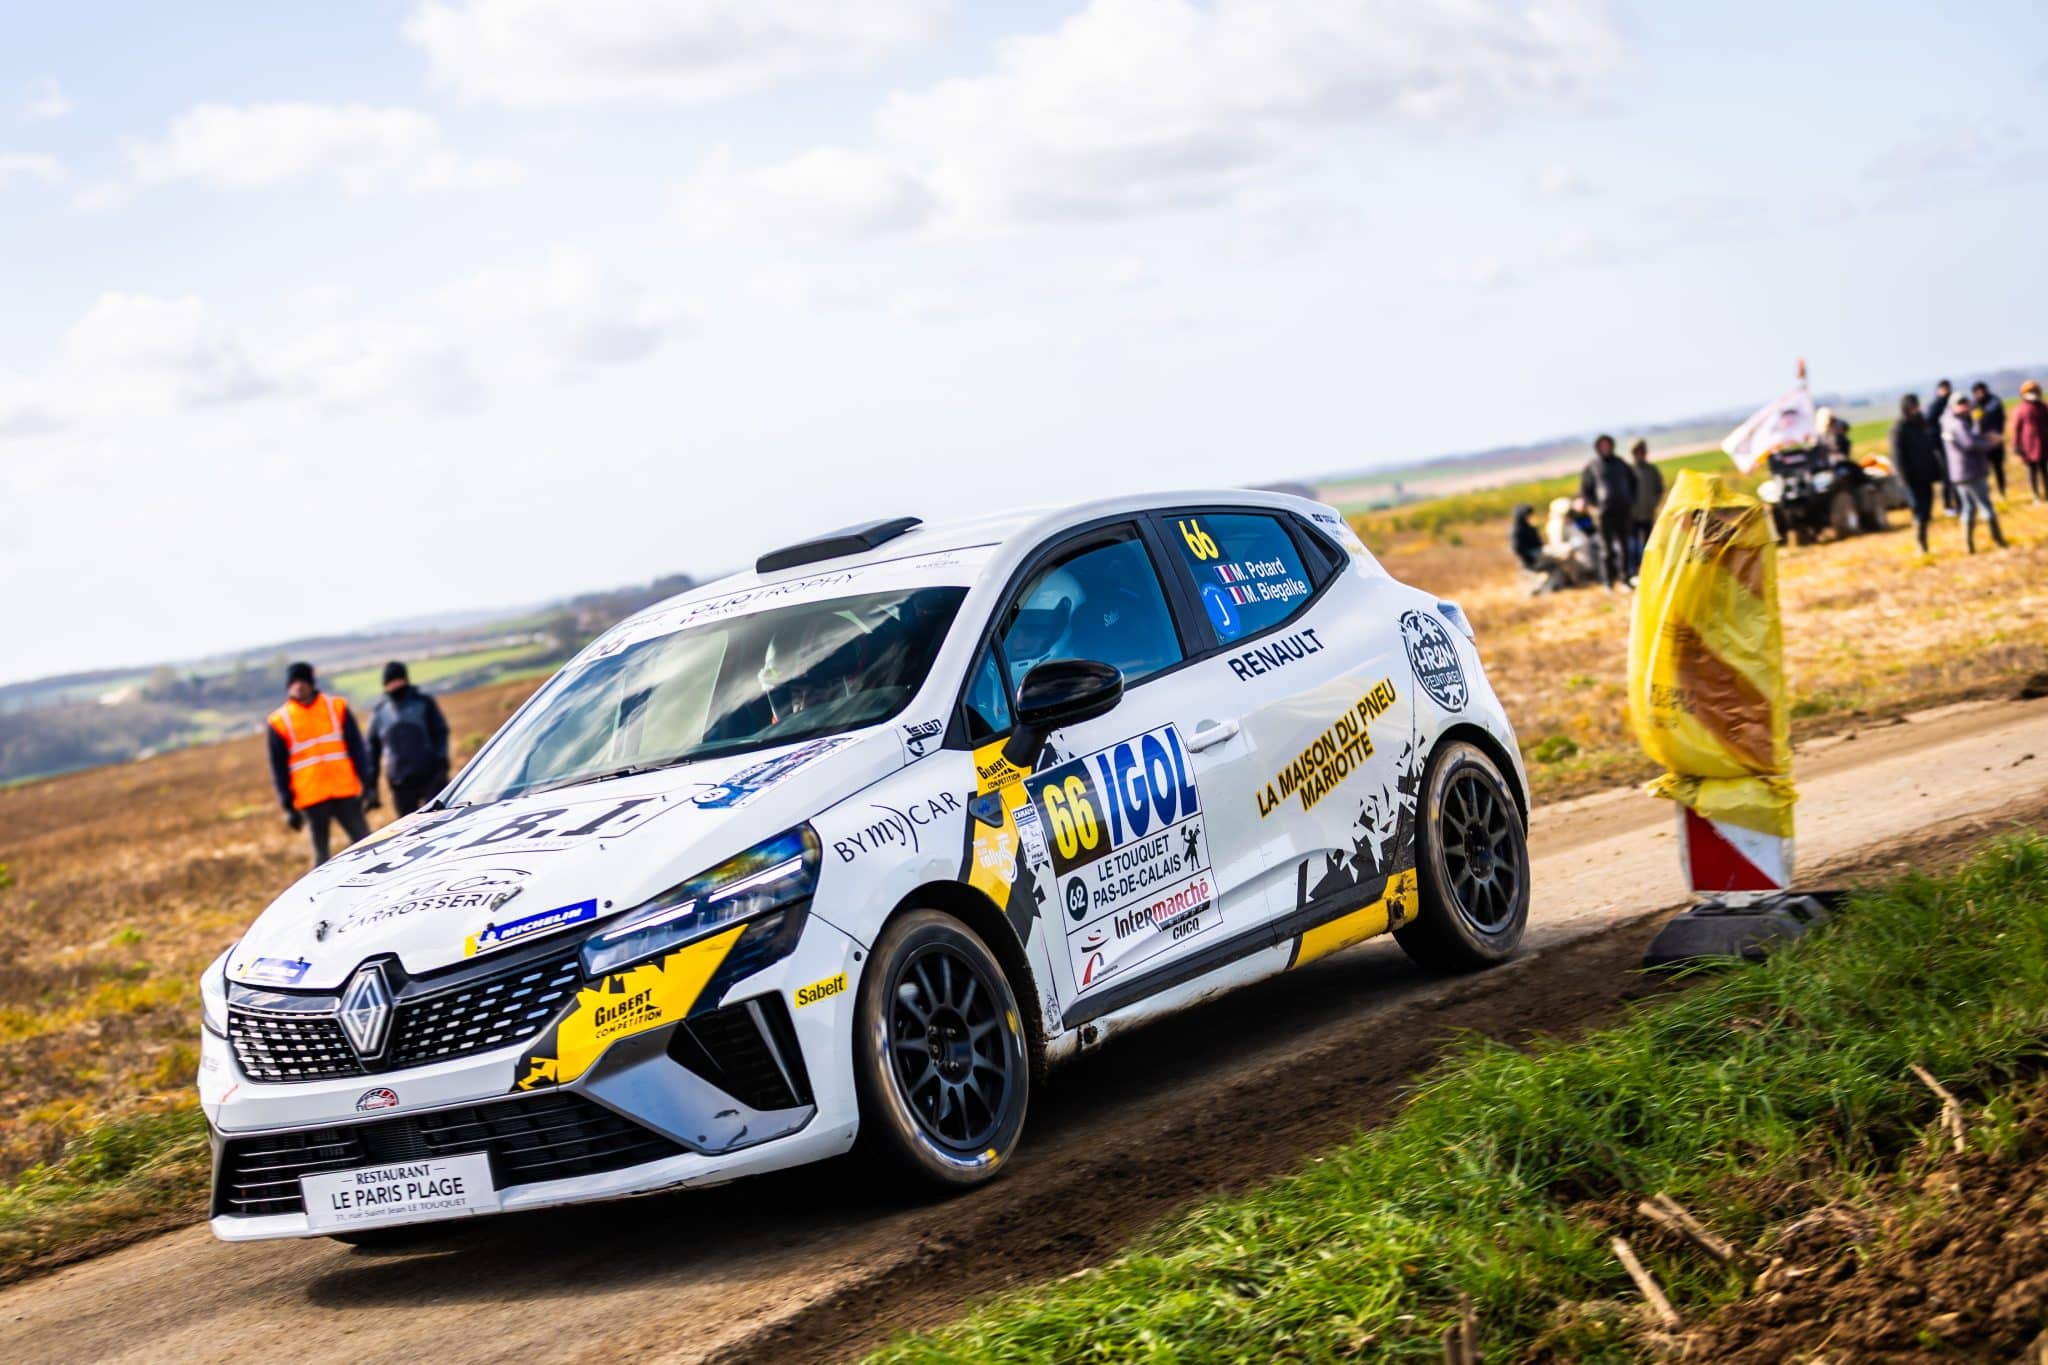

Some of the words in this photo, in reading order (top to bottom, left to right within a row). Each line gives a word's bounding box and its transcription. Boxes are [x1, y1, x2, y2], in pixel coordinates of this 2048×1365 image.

[1179, 519, 1219, 560] 66
[1229, 563, 1248, 581] M.
[1245, 557, 1286, 578] Potard
[1241, 585, 1260, 603] M.
[1257, 577, 1307, 602] Biegalke
[1227, 629, 1324, 682] RENAULT
[1256, 784, 1279, 818] LA
[1278, 733, 1335, 798] MAISON
[1334, 709, 1358, 745] DU
[1357, 678, 1397, 726] PNEU
[977, 758, 1007, 780] GILBERT
[988, 773, 1020, 789] COMPETITION
[1300, 731, 1374, 811] MARIOTTE
[1096, 727, 1197, 846] IGOL
[1043, 775, 1098, 859] 66
[1098, 861, 1114, 881] LE
[1114, 835, 1169, 874] TOUQUET
[1069, 882, 1086, 912] 62
[1093, 854, 1181, 909] PAS-DE-CALAIS
[501, 907, 582, 939] MICHELIN
[1173, 917, 1199, 940] CUCQ
[797, 976, 844, 1005] Sabelt
[595, 989, 652, 1027] GILBERT
[595, 1009, 662, 1038] COMPETITION
[356, 1165, 430, 1185] RESTAURANT
[331, 1192, 351, 1210] LE
[356, 1185, 401, 1206] PARIS
[407, 1177, 465, 1200] PLAGE
[408, 1204, 417, 1212] LE
[421, 1198, 466, 1210] TOUQUET
